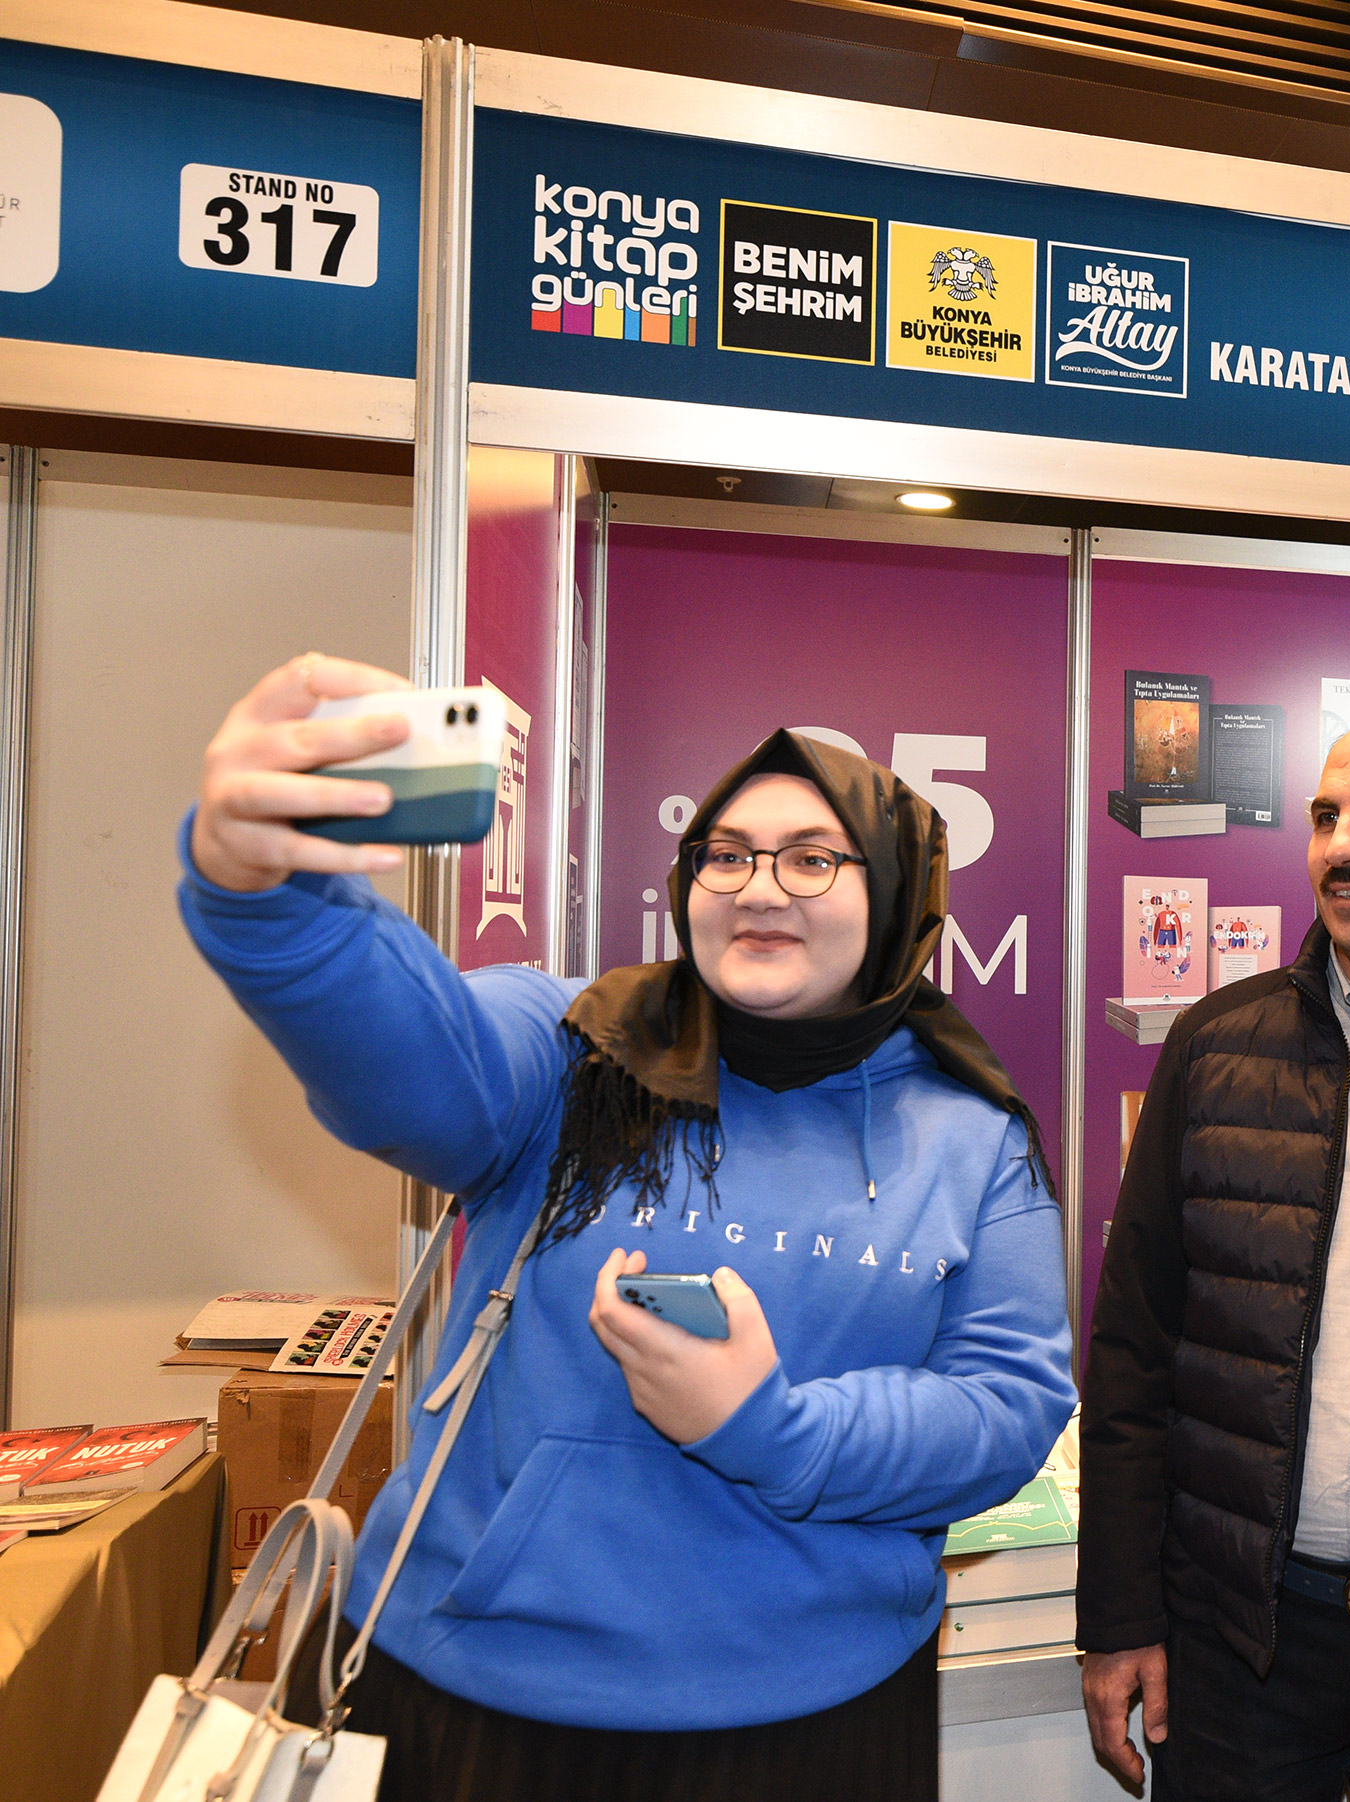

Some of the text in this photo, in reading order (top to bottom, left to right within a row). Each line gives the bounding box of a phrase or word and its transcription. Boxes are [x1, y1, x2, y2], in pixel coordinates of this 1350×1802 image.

[228, 171, 334, 205] STAND NO
[535, 173, 700, 238] konya
[203, 196, 357, 278] 317
[533, 214, 698, 286] kitap
[1085, 262, 1155, 292] UĞUR
[531, 272, 698, 318] günleri
[932, 305, 992, 327] KONYA
[901, 320, 1022, 352] BÜYÜKŞEHİR
[1056, 305, 1179, 371] Altay
[925, 345, 998, 363] BELEDİYESİ
[1061, 365, 1081, 373] KONYA
[0, 1446, 60, 1463] TUK
[70, 1437, 177, 1461] NUTUK
